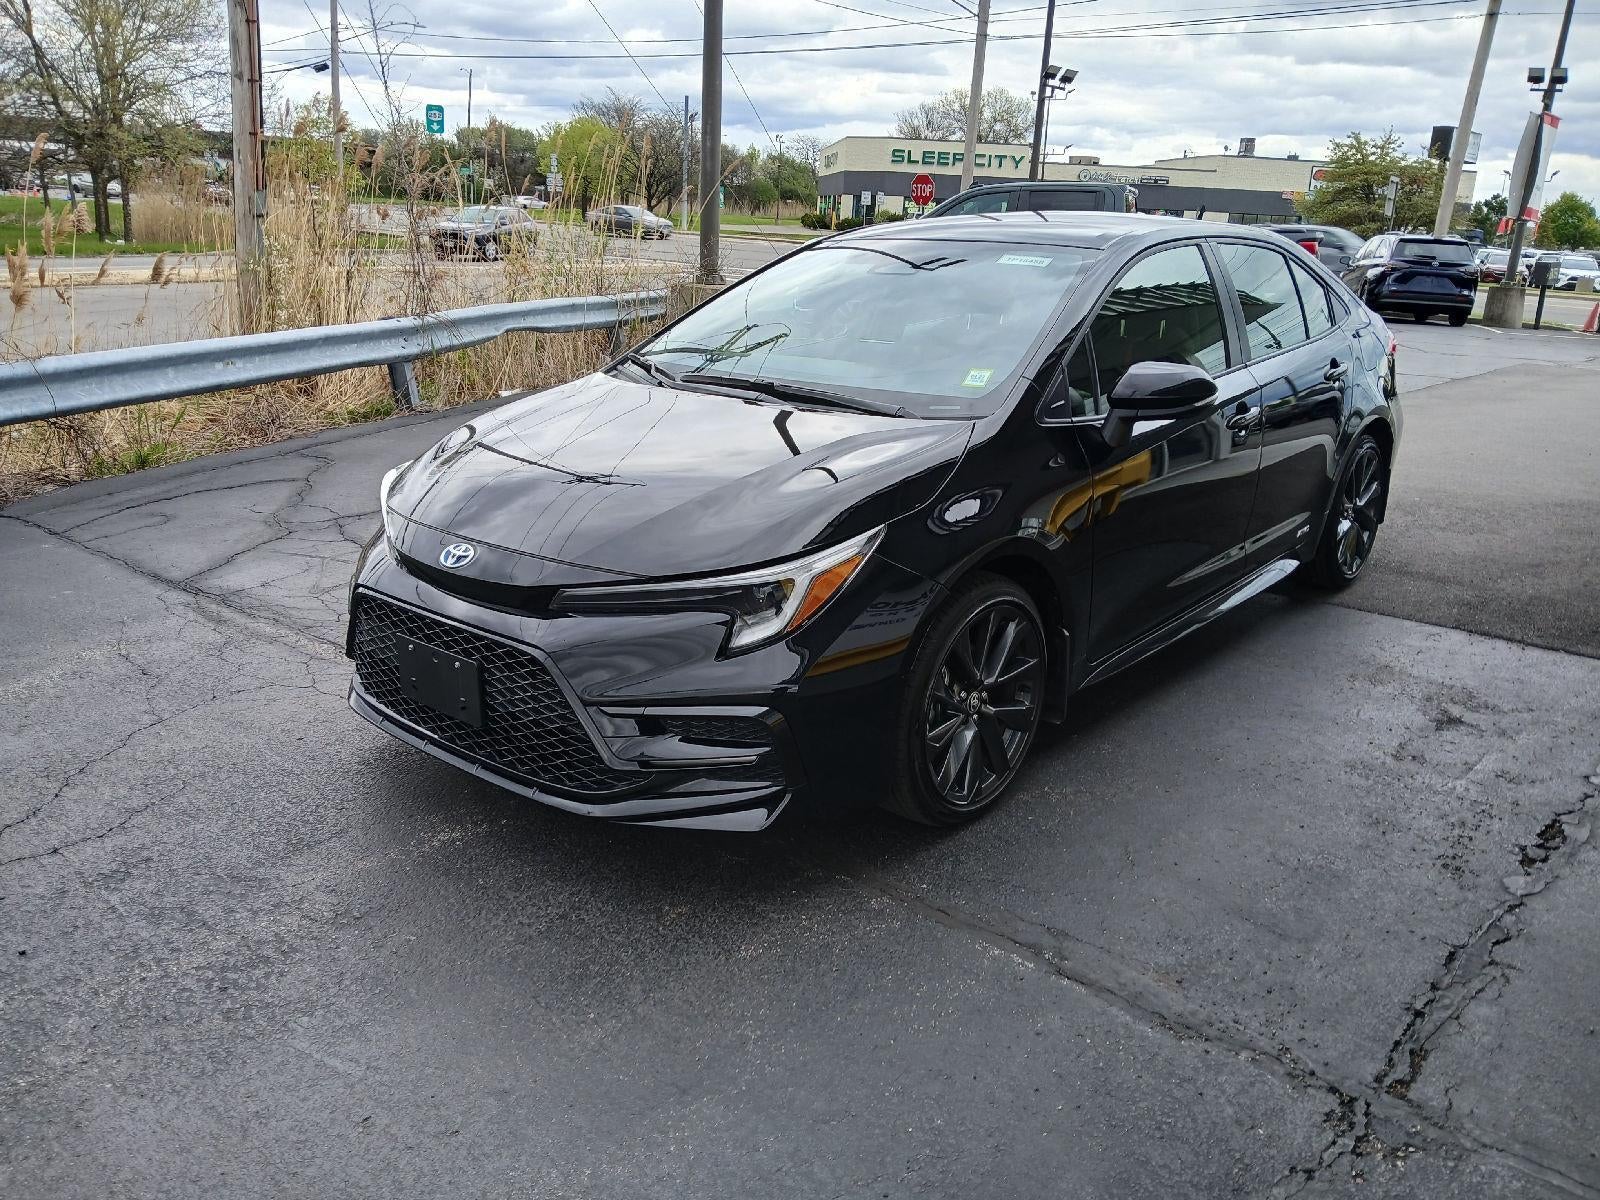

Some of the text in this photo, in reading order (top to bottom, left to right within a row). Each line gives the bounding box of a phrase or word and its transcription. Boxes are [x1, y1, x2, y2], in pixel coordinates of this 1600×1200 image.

[891, 148, 1026, 169] SLEEP CITY
[912, 184, 933, 197] STOP
